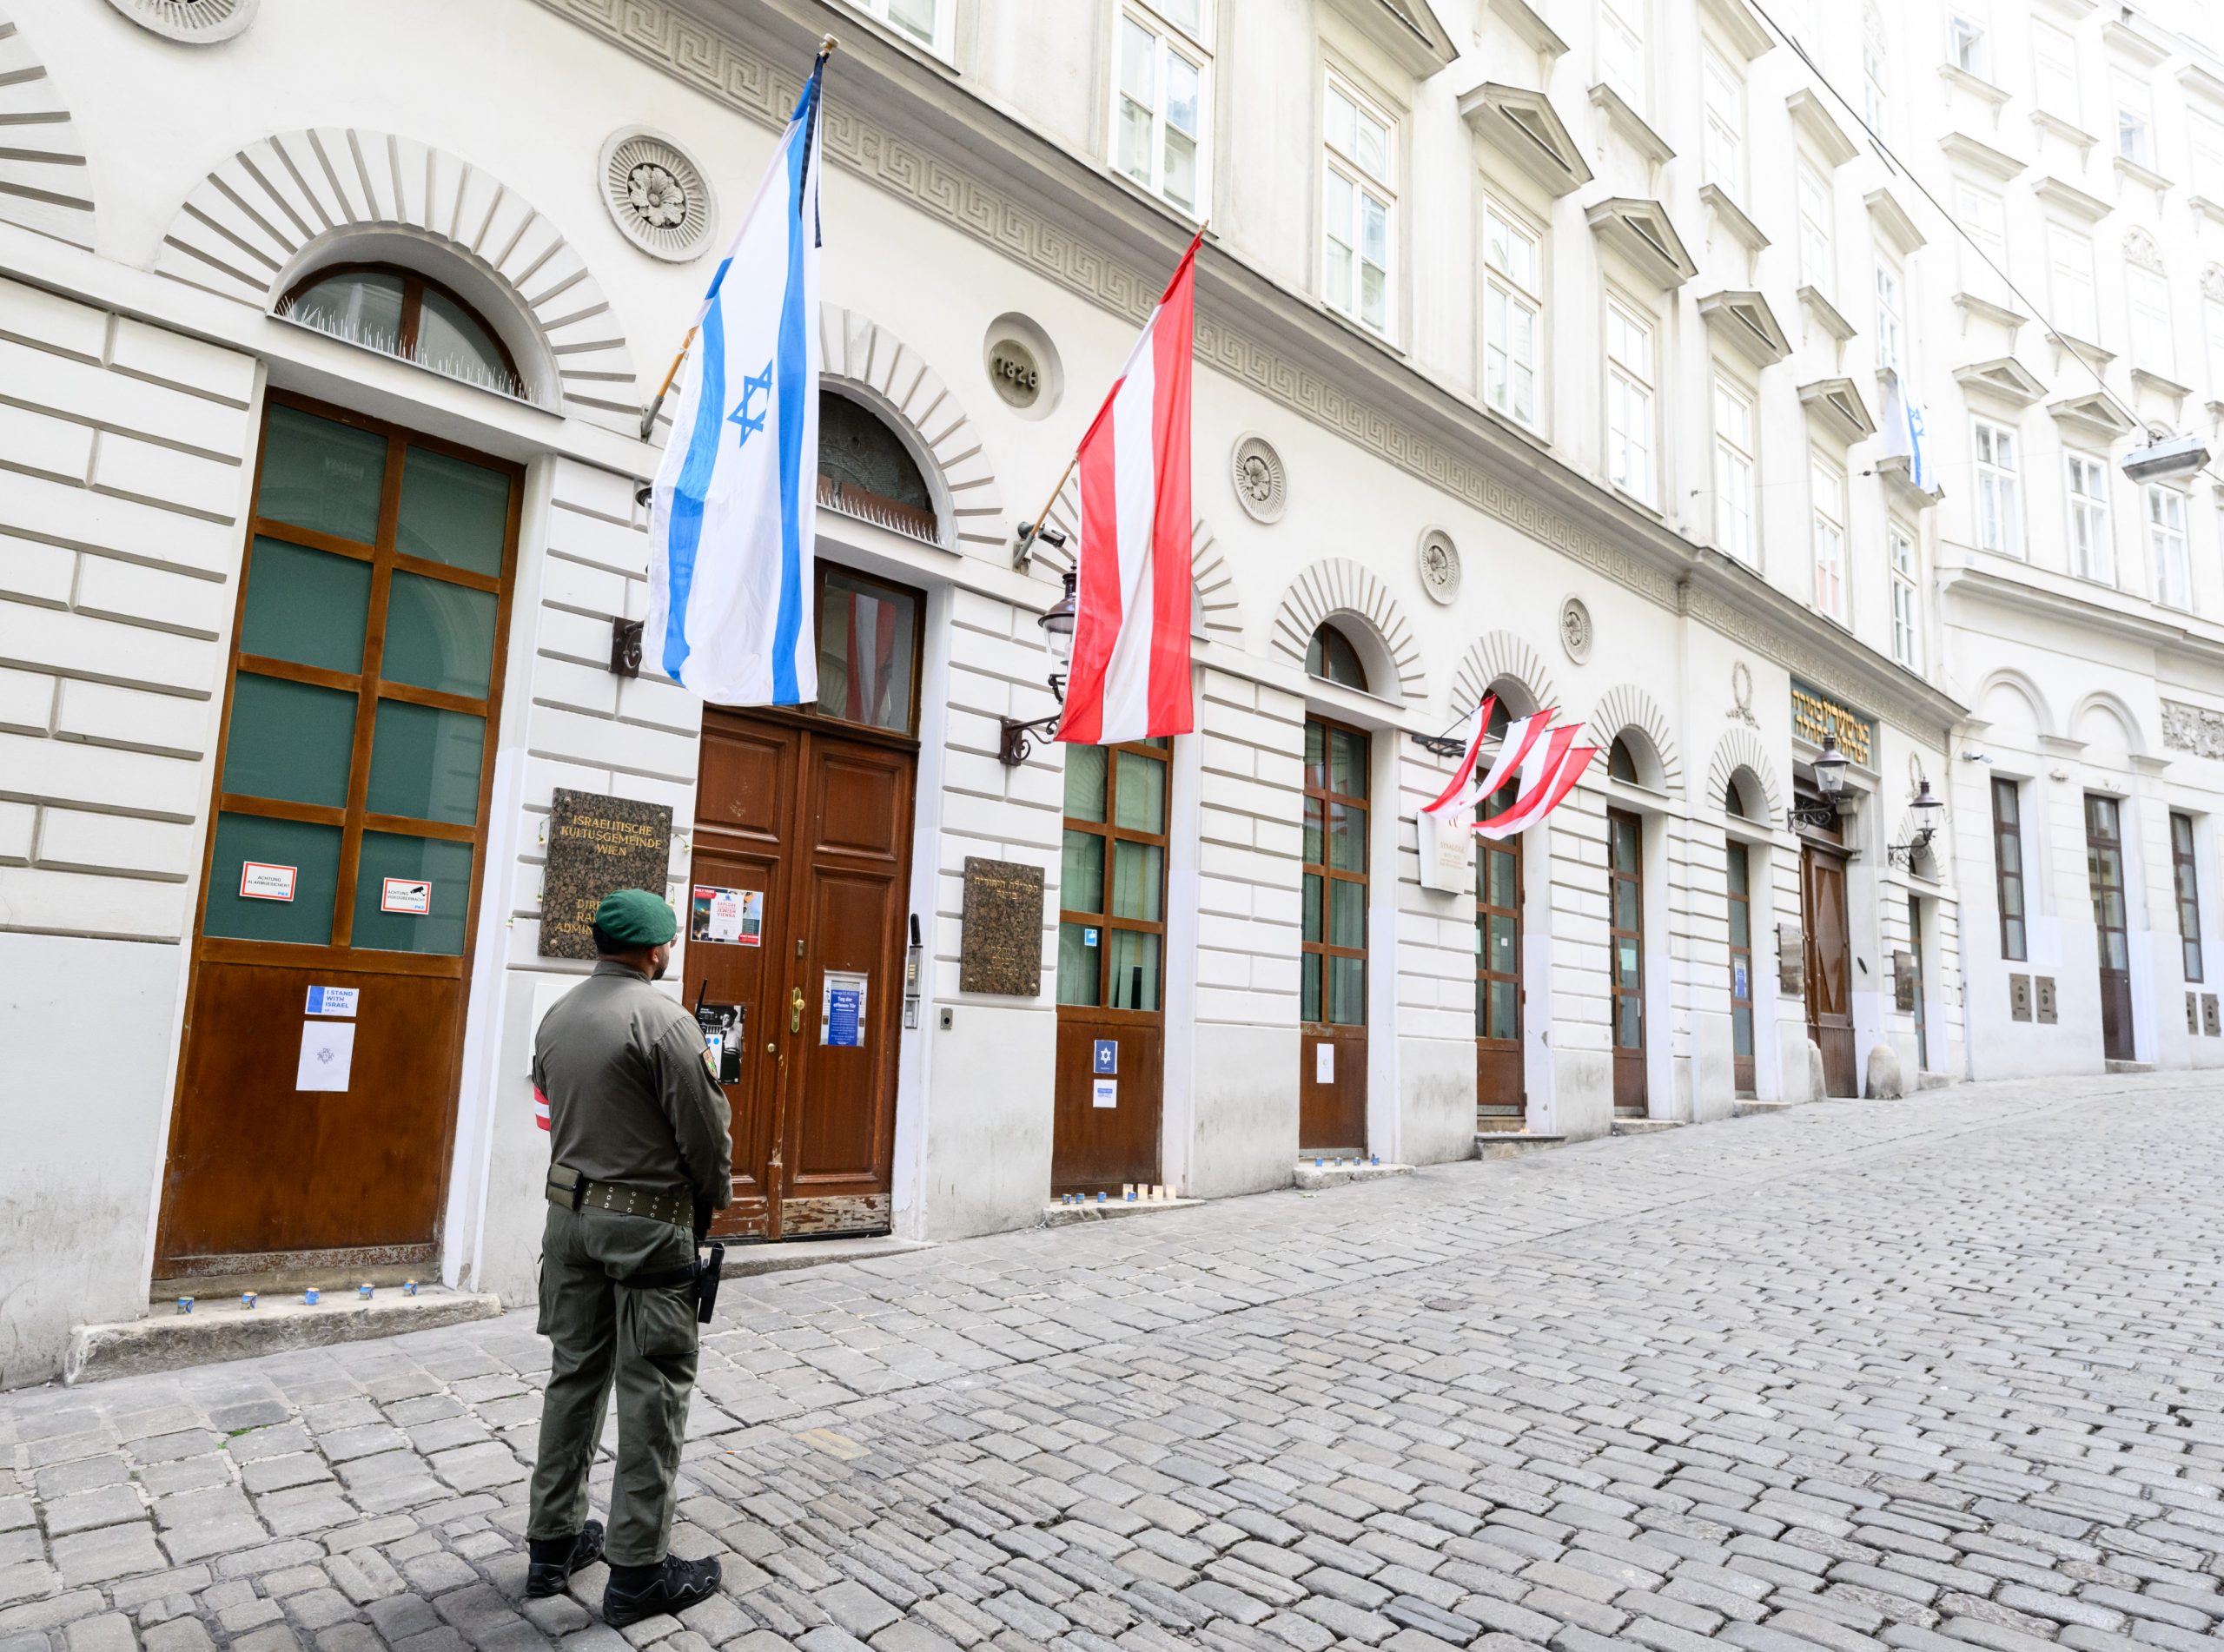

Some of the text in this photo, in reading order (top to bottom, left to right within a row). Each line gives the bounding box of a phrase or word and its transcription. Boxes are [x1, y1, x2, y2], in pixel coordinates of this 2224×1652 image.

[996, 358, 1037, 388] 1826
[573, 814, 653, 836] ISRAELITISCHE
[560, 825, 662, 849] KULTUSGEMEINDE
[597, 843, 627, 856] WIEN
